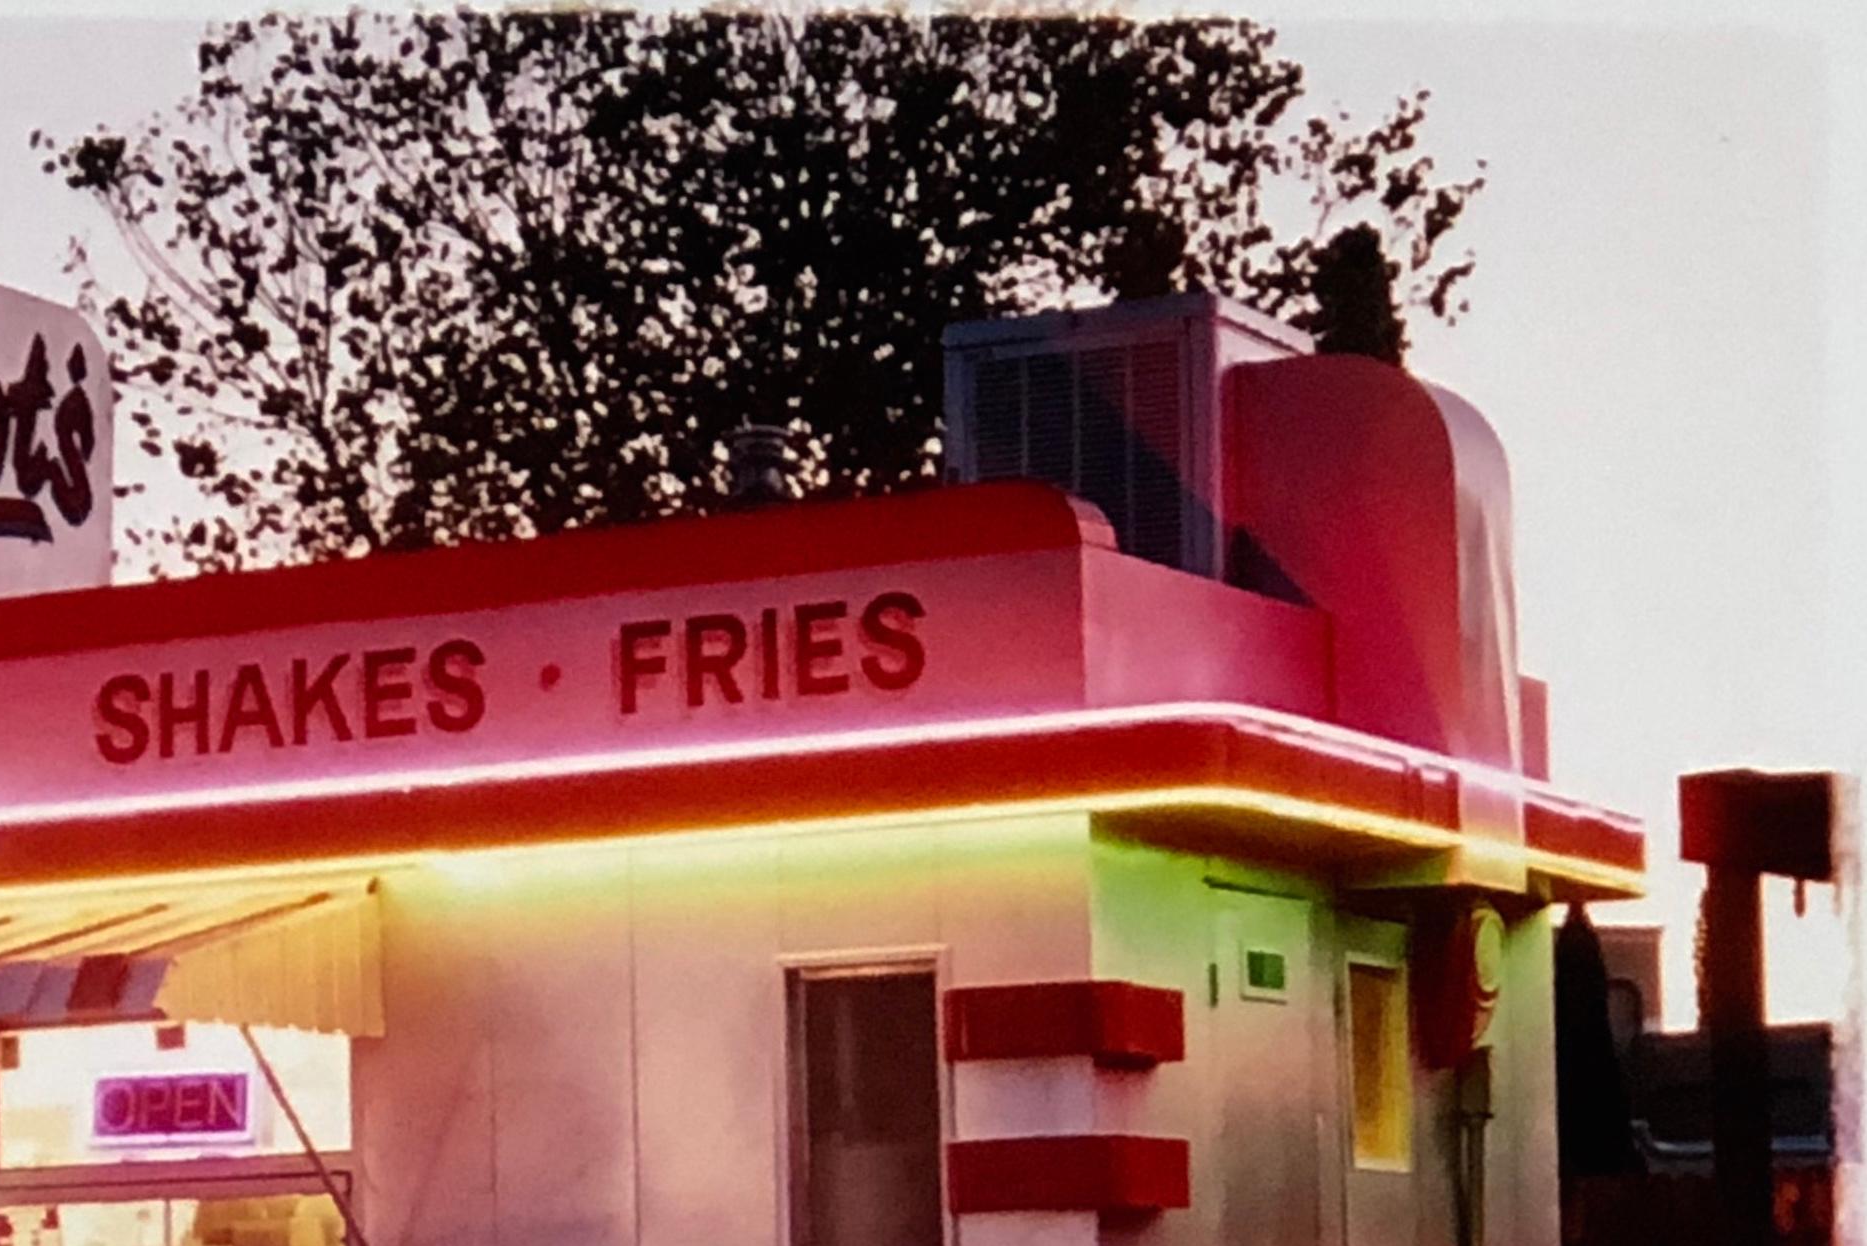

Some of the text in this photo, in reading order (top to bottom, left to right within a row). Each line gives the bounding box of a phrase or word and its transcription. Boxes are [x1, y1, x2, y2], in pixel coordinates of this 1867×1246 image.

[93, 590, 927, 766] SHAKES FRIES
[97, 1074, 246, 1133] OPEN
